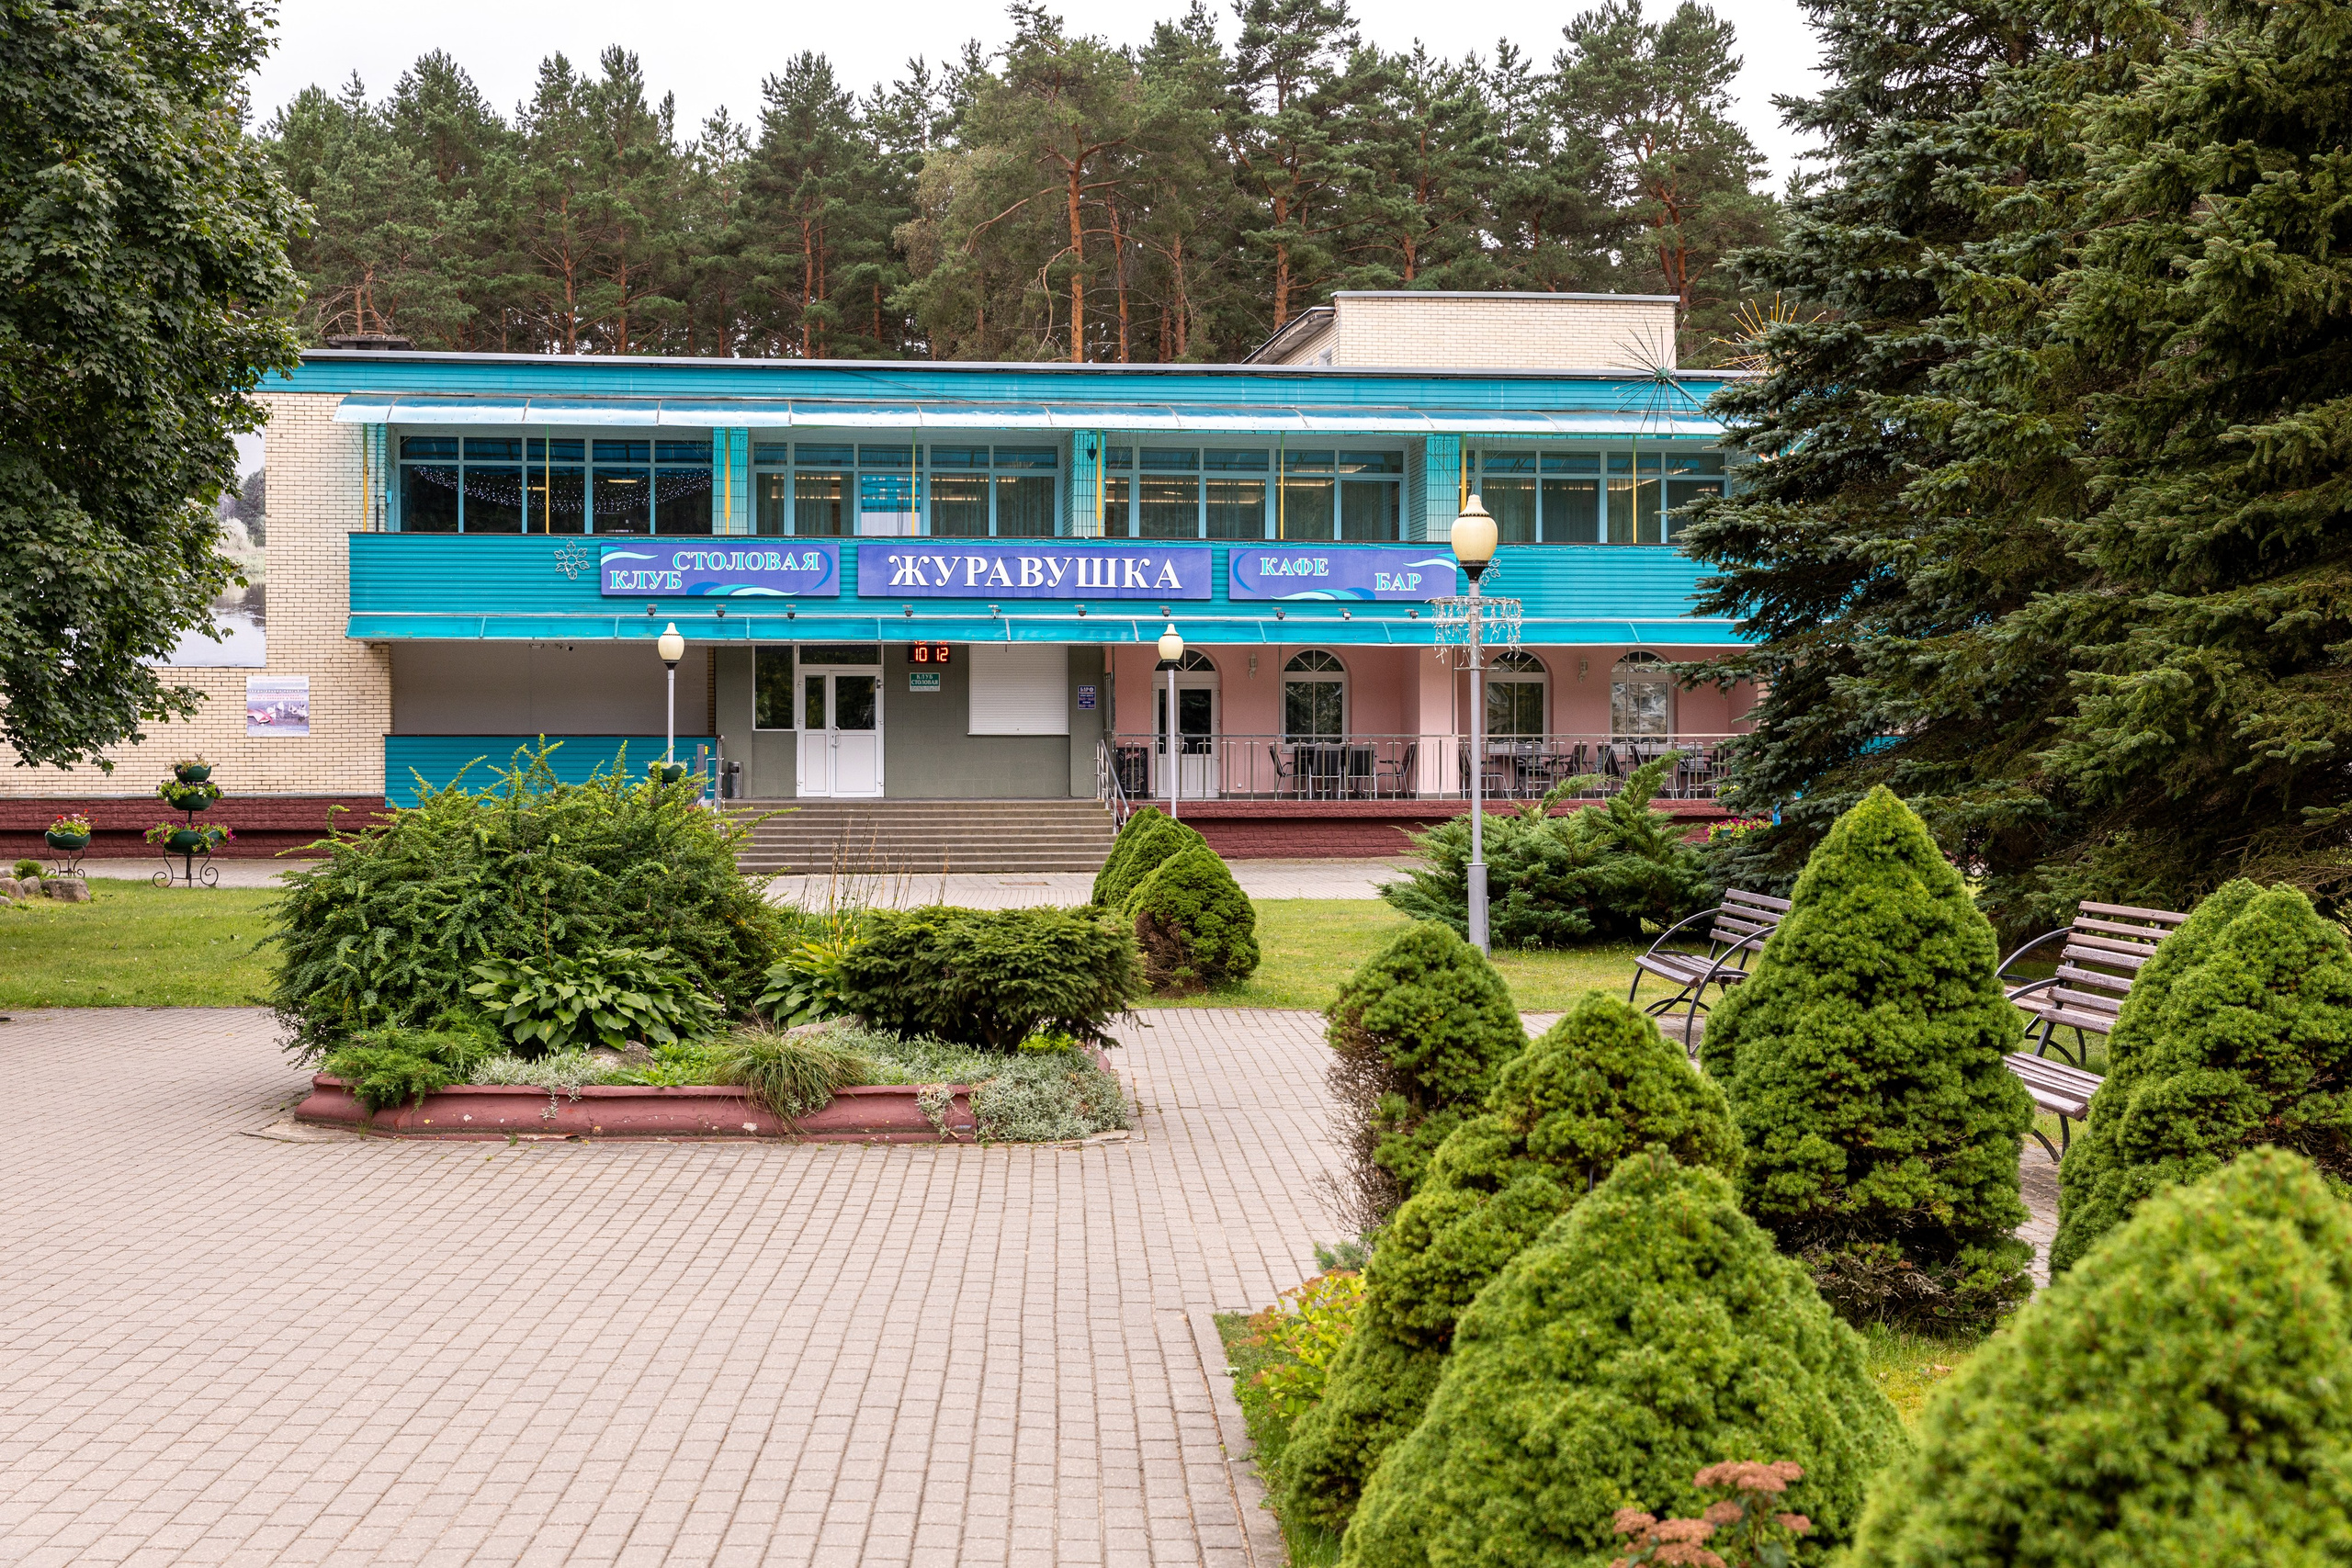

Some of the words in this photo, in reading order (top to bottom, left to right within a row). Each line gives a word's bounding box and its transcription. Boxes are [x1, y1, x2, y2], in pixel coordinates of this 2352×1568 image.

[673, 551, 820, 570] СТОЛОВАЯ
[1260, 558, 1329, 576] КАФЕ
[610, 570, 682, 590] КЛУБ
[888, 555, 1183, 589] ЖУРАВУШКА
[1374, 572, 1422, 591] БАР
[915, 647, 928, 661] 10
[936, 647, 949, 661] 12
